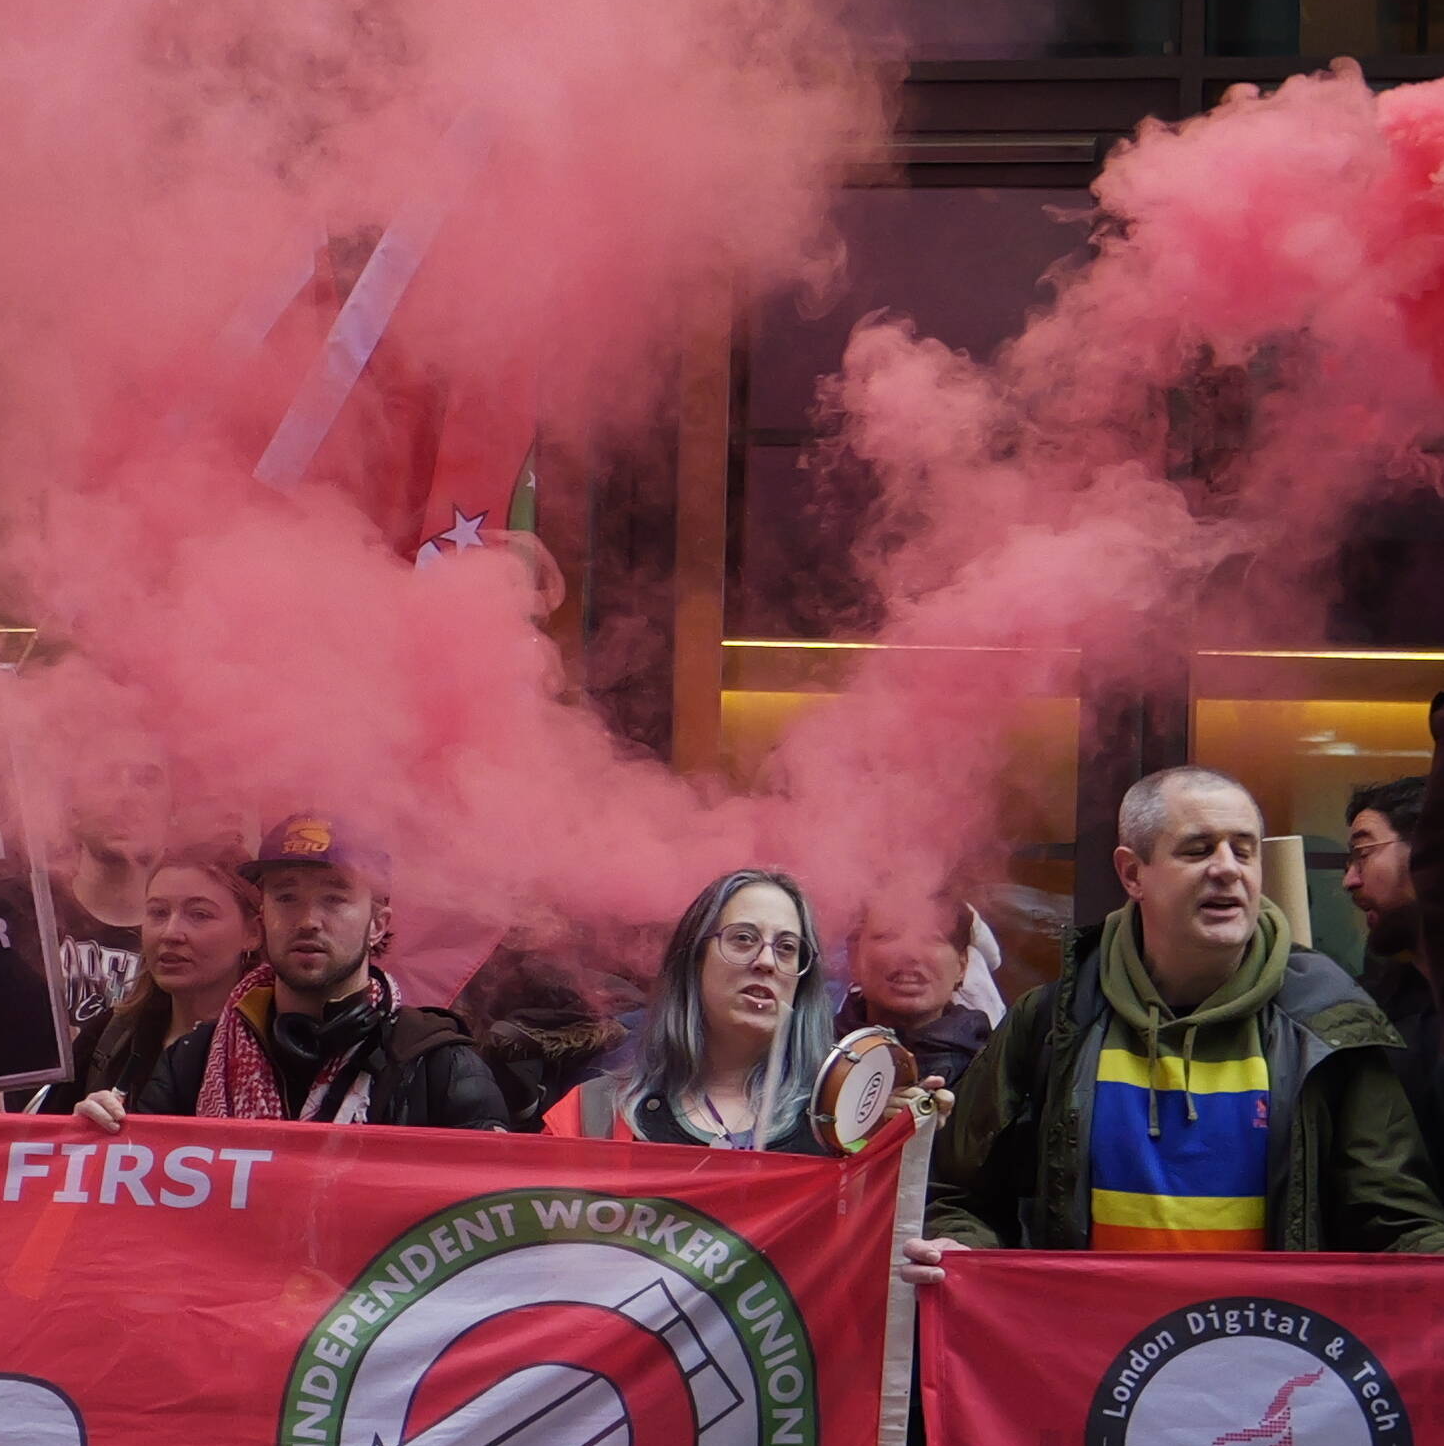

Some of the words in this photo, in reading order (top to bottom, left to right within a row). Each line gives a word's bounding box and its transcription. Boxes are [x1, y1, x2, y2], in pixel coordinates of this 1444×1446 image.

[2, 1140, 274, 1210] FIRST
[528, 1198, 747, 1285] WORKERS
[1101, 1326, 1177, 1421] London
[1186, 1303, 1312, 1343] Digital
[1323, 1336, 1346, 1362] &
[1350, 1360, 1402, 1434] Tech
